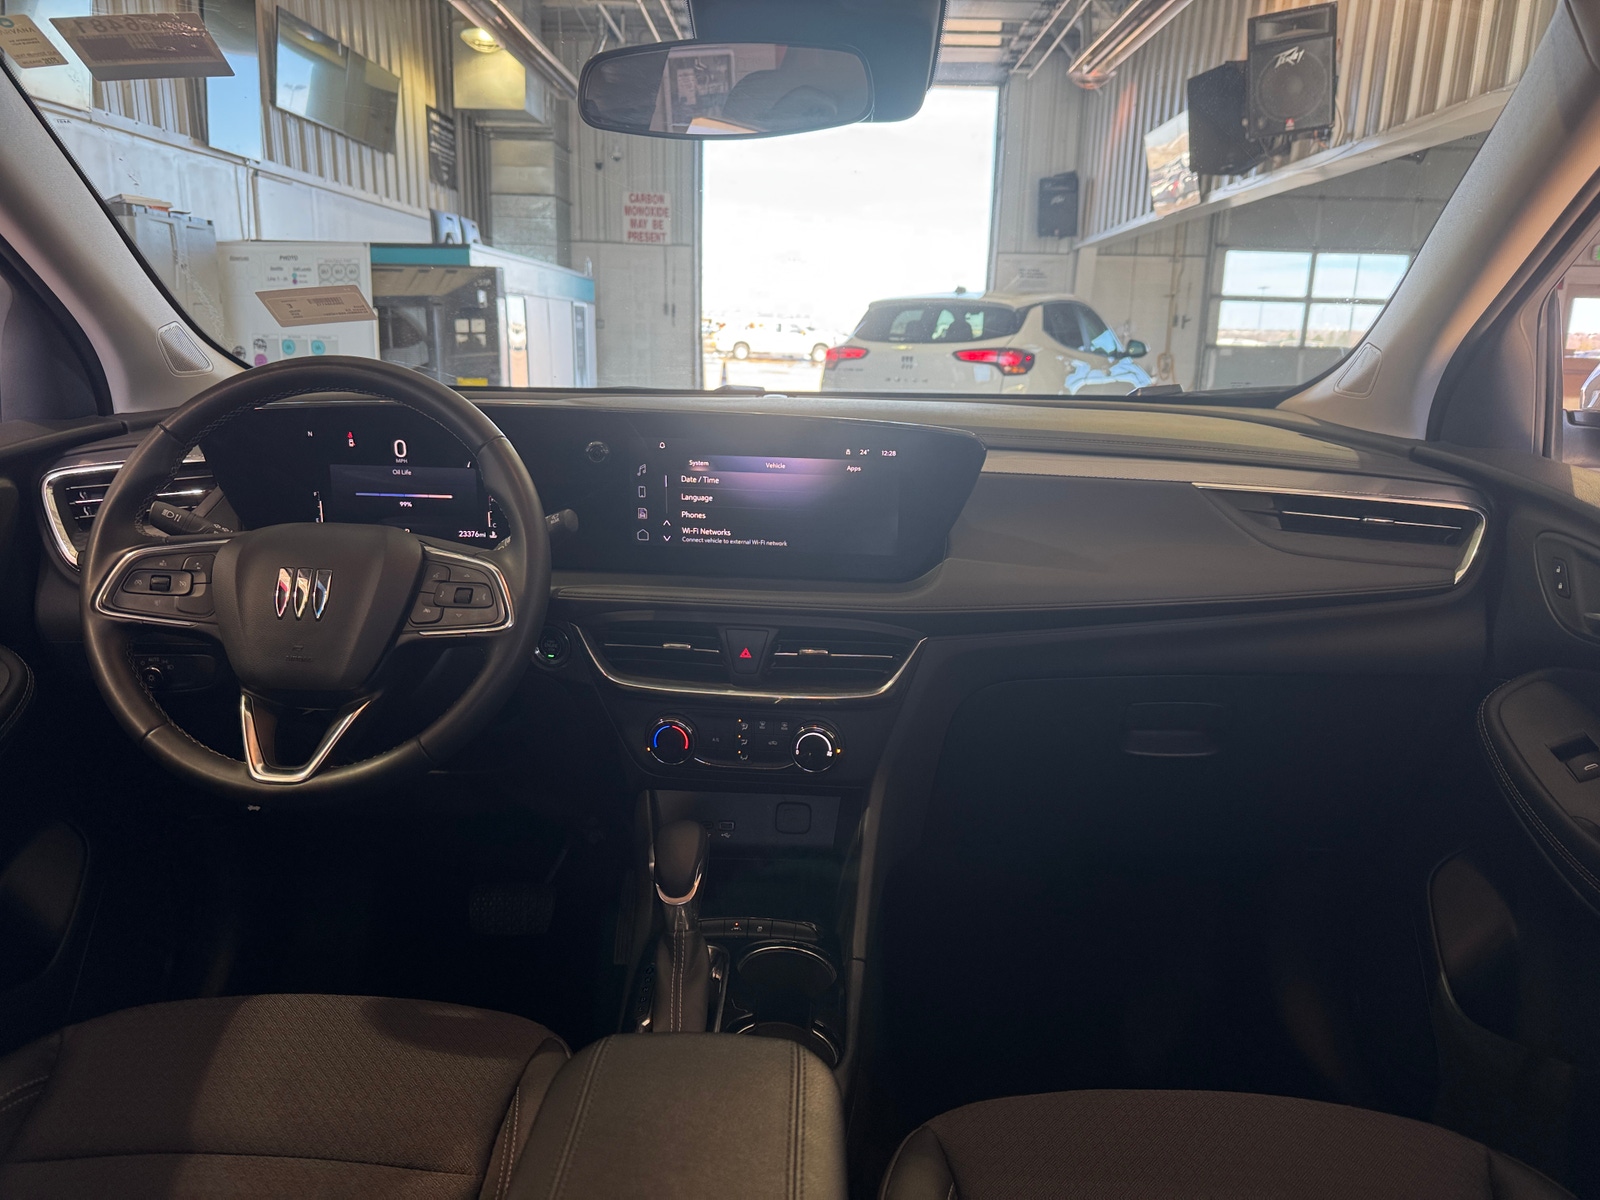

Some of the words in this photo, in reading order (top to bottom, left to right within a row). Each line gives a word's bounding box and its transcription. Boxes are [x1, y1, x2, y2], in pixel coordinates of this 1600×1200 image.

[629, 193, 665, 204] CARBON
[624, 205, 669, 218] MONOXIDE
[630, 219, 648, 229] MAY
[652, 220, 665, 230] BE
[627, 231, 667, 243] PRESENT
[394, 439, 407, 458] 0
[689, 459, 709, 467] System
[681, 475, 698, 484] Date
[703, 476, 720, 484] Time
[681, 493, 713, 503] Language
[681, 511, 706, 519] Phones
[681, 527, 699, 535] Wi-Fi
[700, 527, 731, 536] Networks
